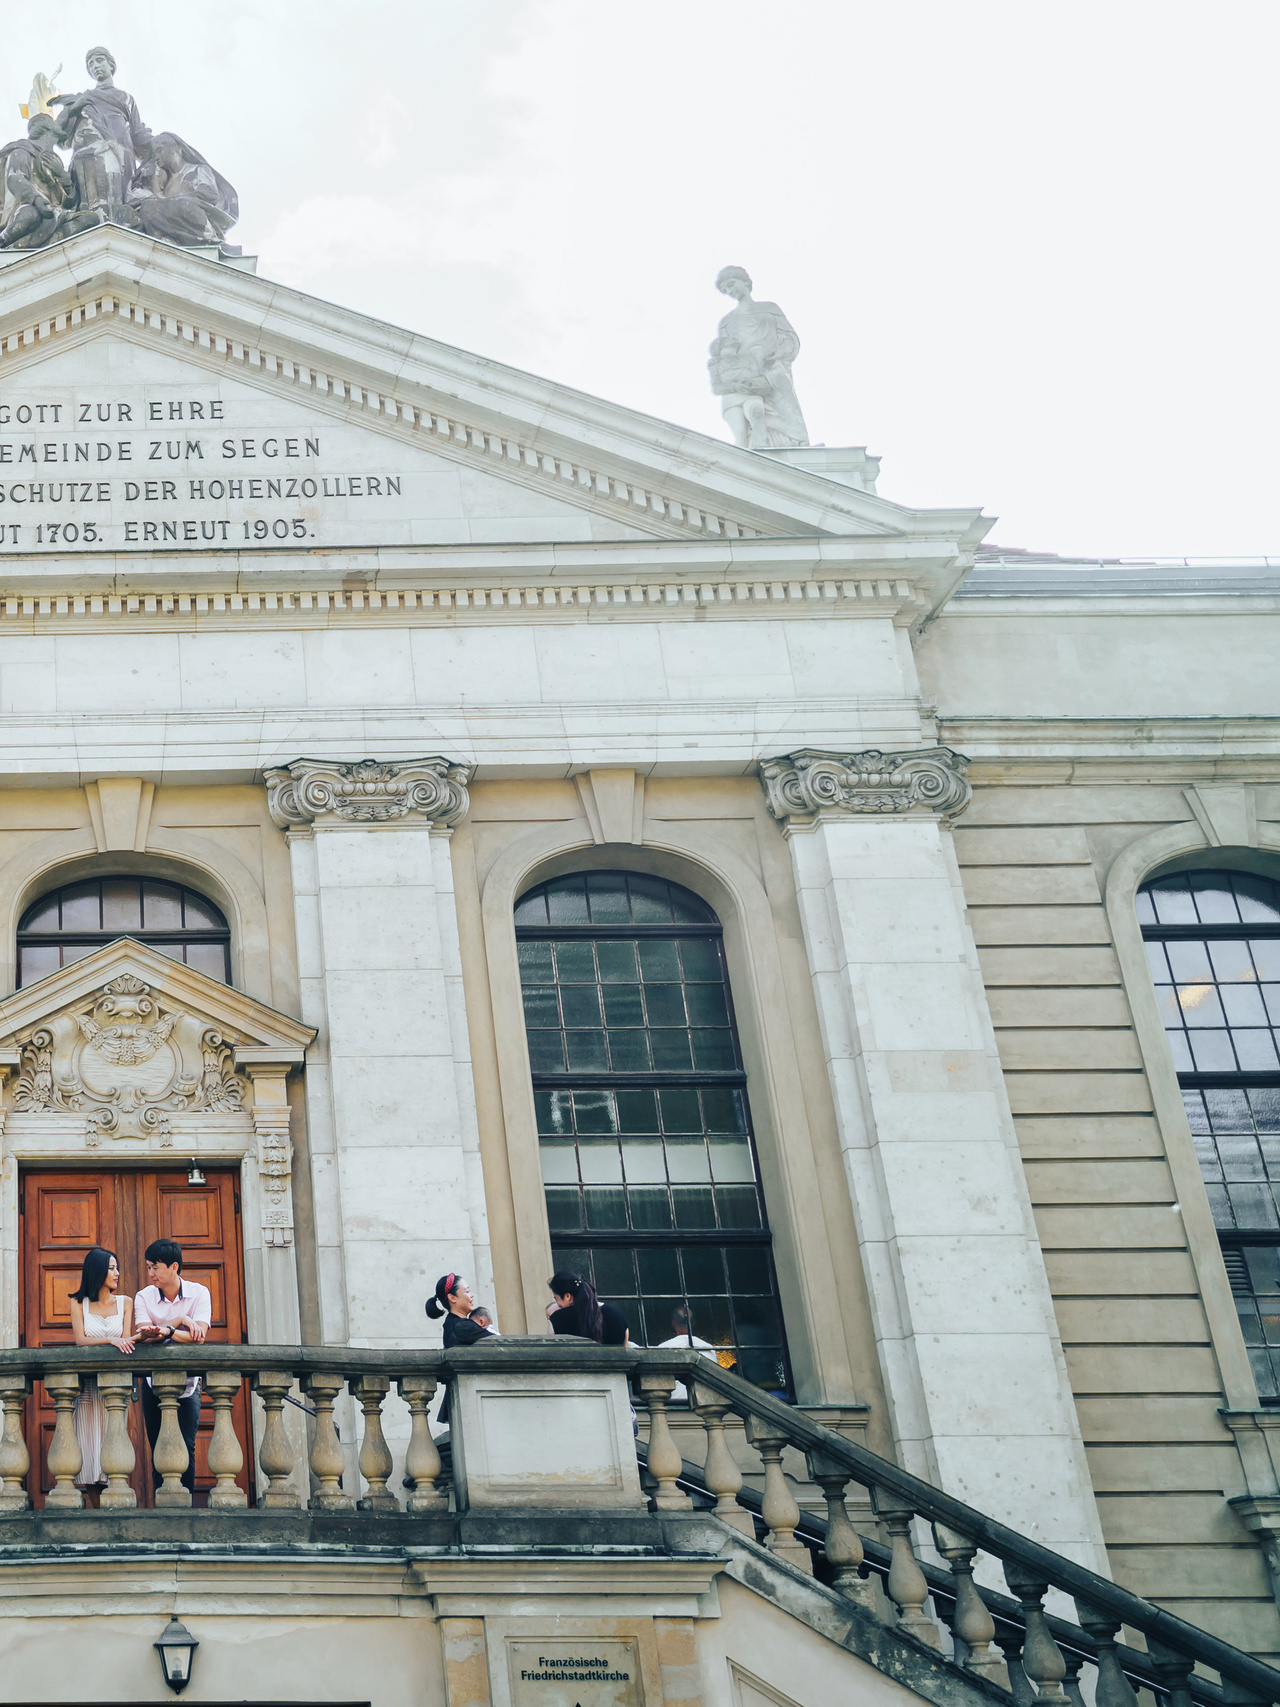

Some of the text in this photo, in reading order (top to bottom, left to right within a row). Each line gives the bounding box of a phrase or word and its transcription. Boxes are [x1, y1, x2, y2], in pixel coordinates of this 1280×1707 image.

[78, 403, 133, 423] ZUR
[149, 400, 224, 421] EHRE
[148, 440, 205, 461] ZUM
[221, 437, 320, 459] SEGEN
[124, 480, 178, 502] DER
[189, 476, 401, 500] HOHENZOLLERN
[36, 522, 104, 544] 1705.
[124, 520, 231, 542] ERNEUT
[242, 518, 315, 540] 1905.
[538, 1656, 609, 1668] Französische
[520, 1669, 630, 1682] Friedrichstadtkirche
